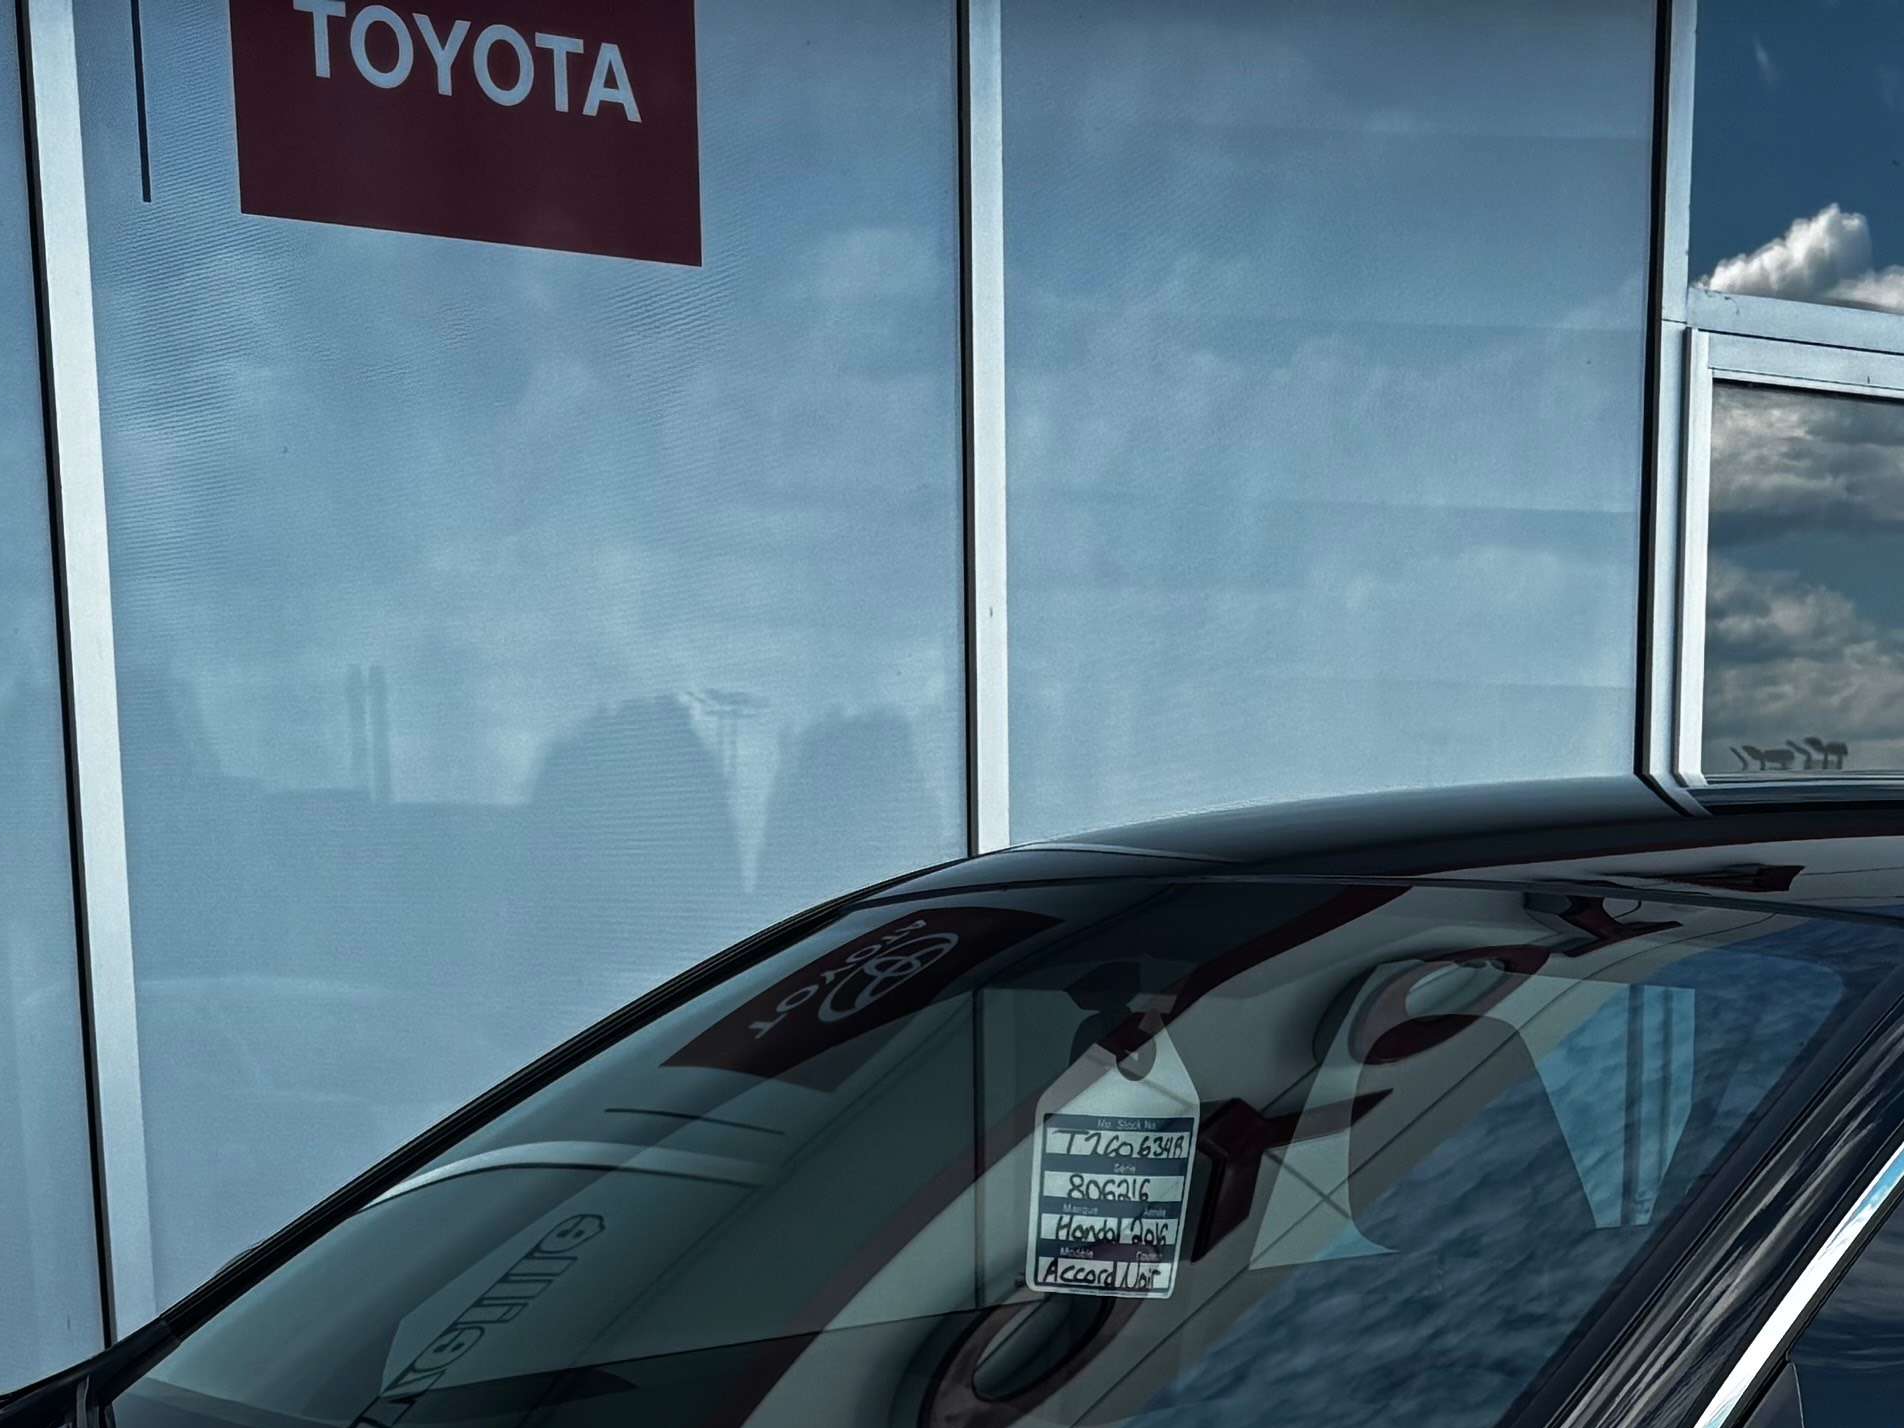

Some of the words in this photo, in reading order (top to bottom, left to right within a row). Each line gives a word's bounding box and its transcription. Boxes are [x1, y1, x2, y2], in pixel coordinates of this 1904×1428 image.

[293, 0, 643, 123] TOYOTA
[1067, 1173, 1151, 1202] 806216
[1055, 1215, 1116, 1244] Honda
[1042, 1257, 1116, 1288] Accord
